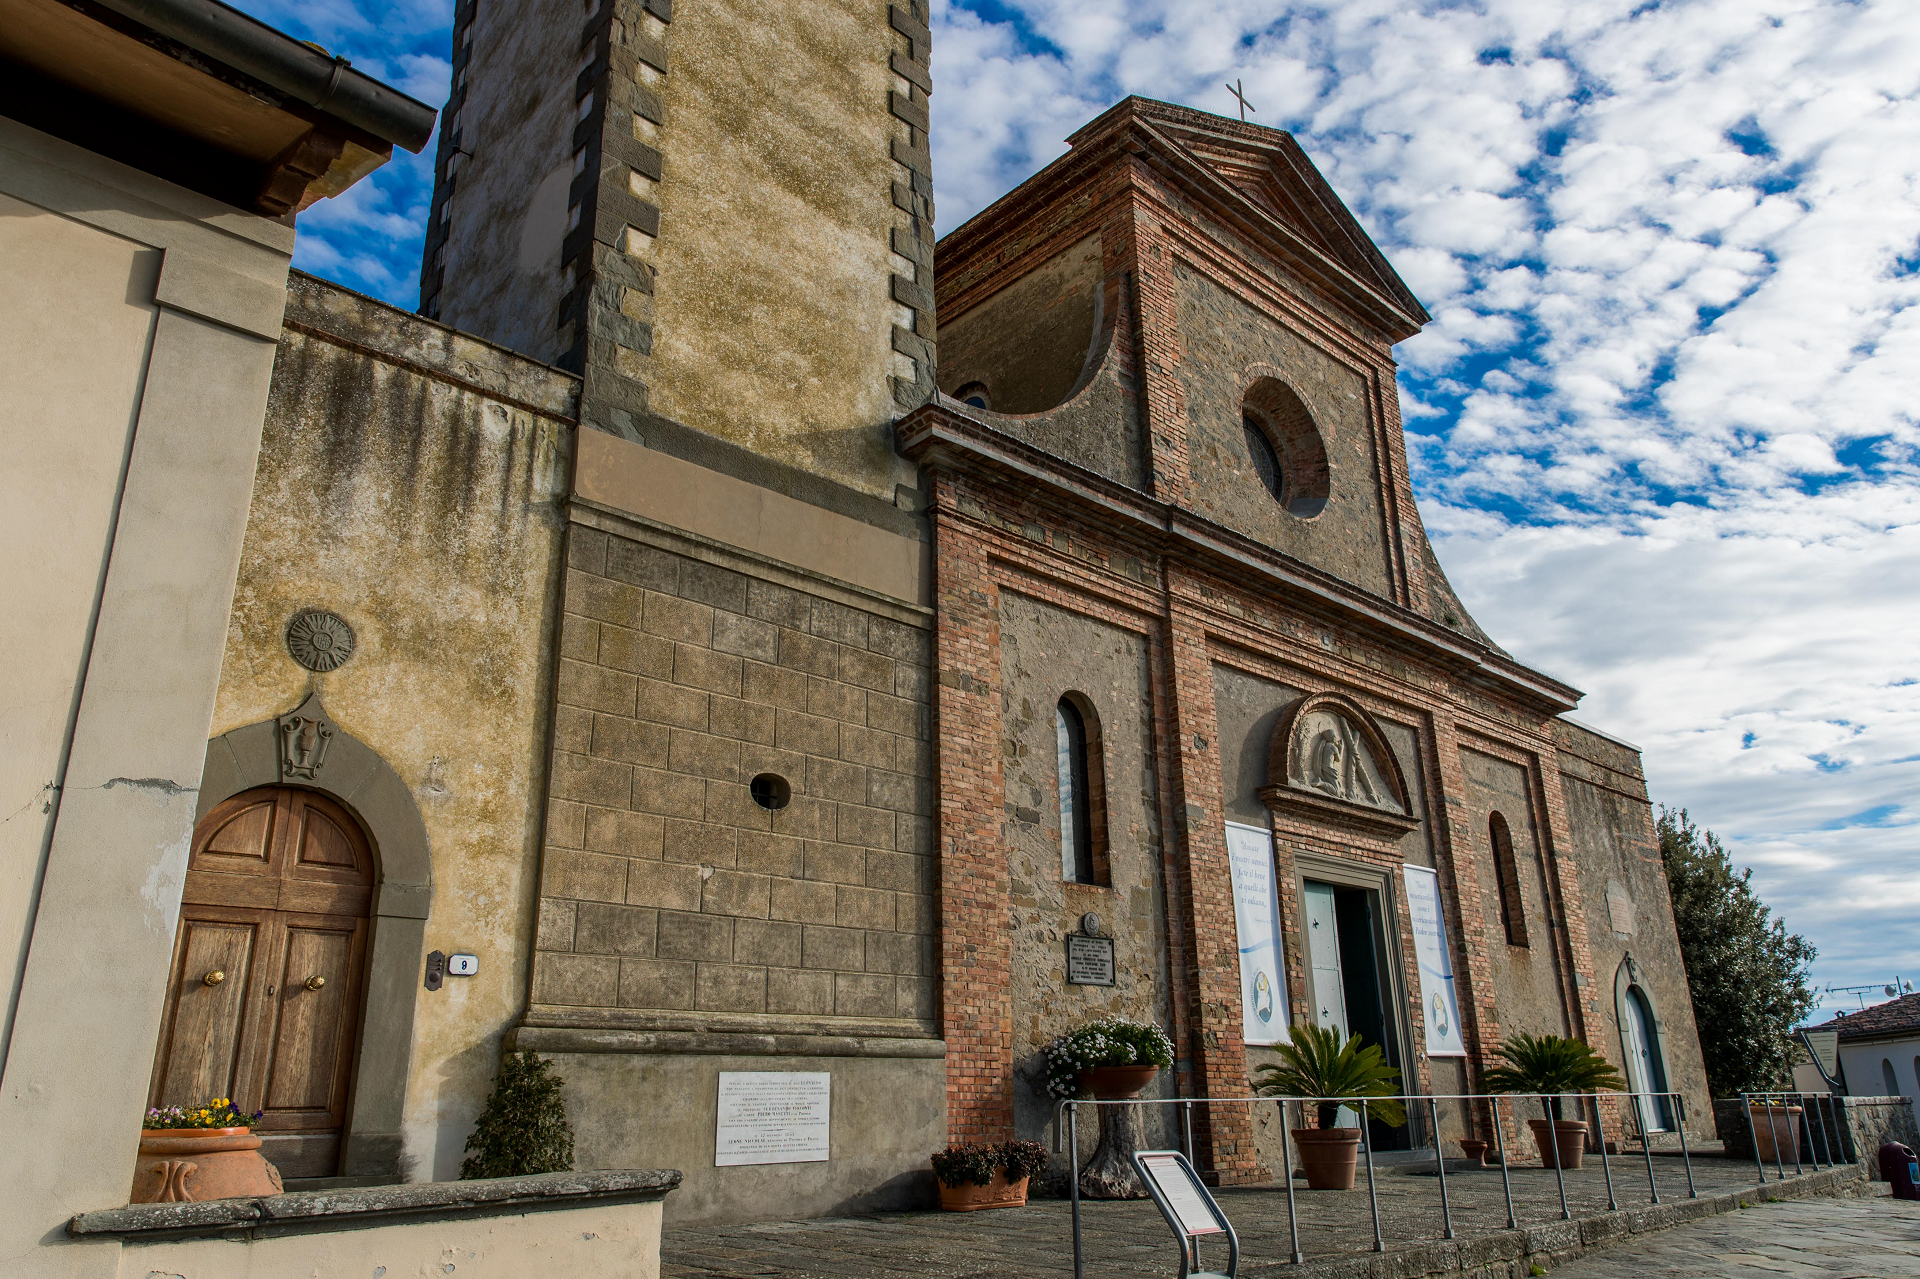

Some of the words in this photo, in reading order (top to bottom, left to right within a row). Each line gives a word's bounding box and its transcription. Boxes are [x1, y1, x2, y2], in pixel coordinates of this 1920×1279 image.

[1235, 855, 1251, 864] vostri
[1237, 866, 1249, 878] fate
[1249, 868, 1254, 878] il
[1255, 871, 1266, 880] bene
[1243, 882, 1258, 893] quelli
[1258, 884, 1268, 894] che
[1241, 895, 1247, 904] vi
[1415, 927, 1428, 935] Padre
[461, 960, 468, 970] 9
